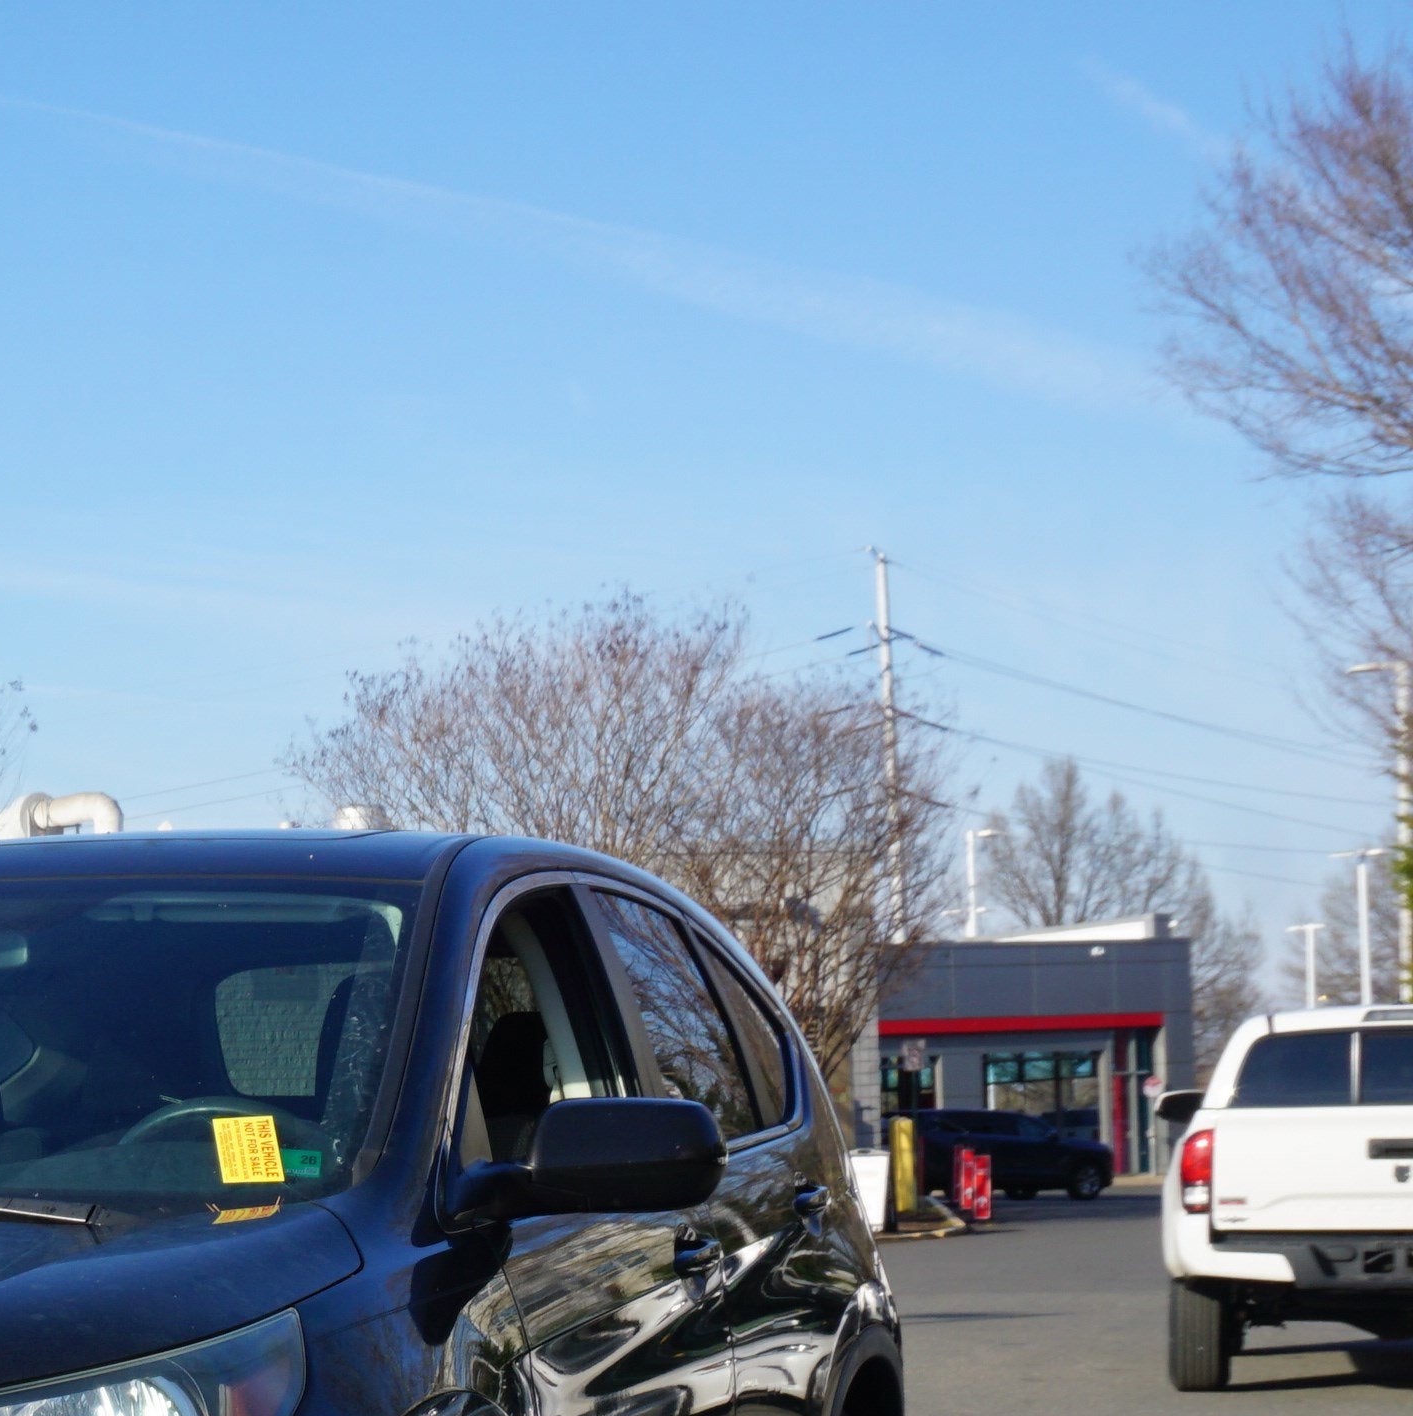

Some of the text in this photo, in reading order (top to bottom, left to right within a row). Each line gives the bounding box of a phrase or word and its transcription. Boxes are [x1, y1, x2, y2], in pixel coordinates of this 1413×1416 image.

[243, 1122, 262, 1175] NOT FOR SALE
[256, 1119, 279, 1177] THIS VEHICLE
[300, 1155, 317, 1165] 26
